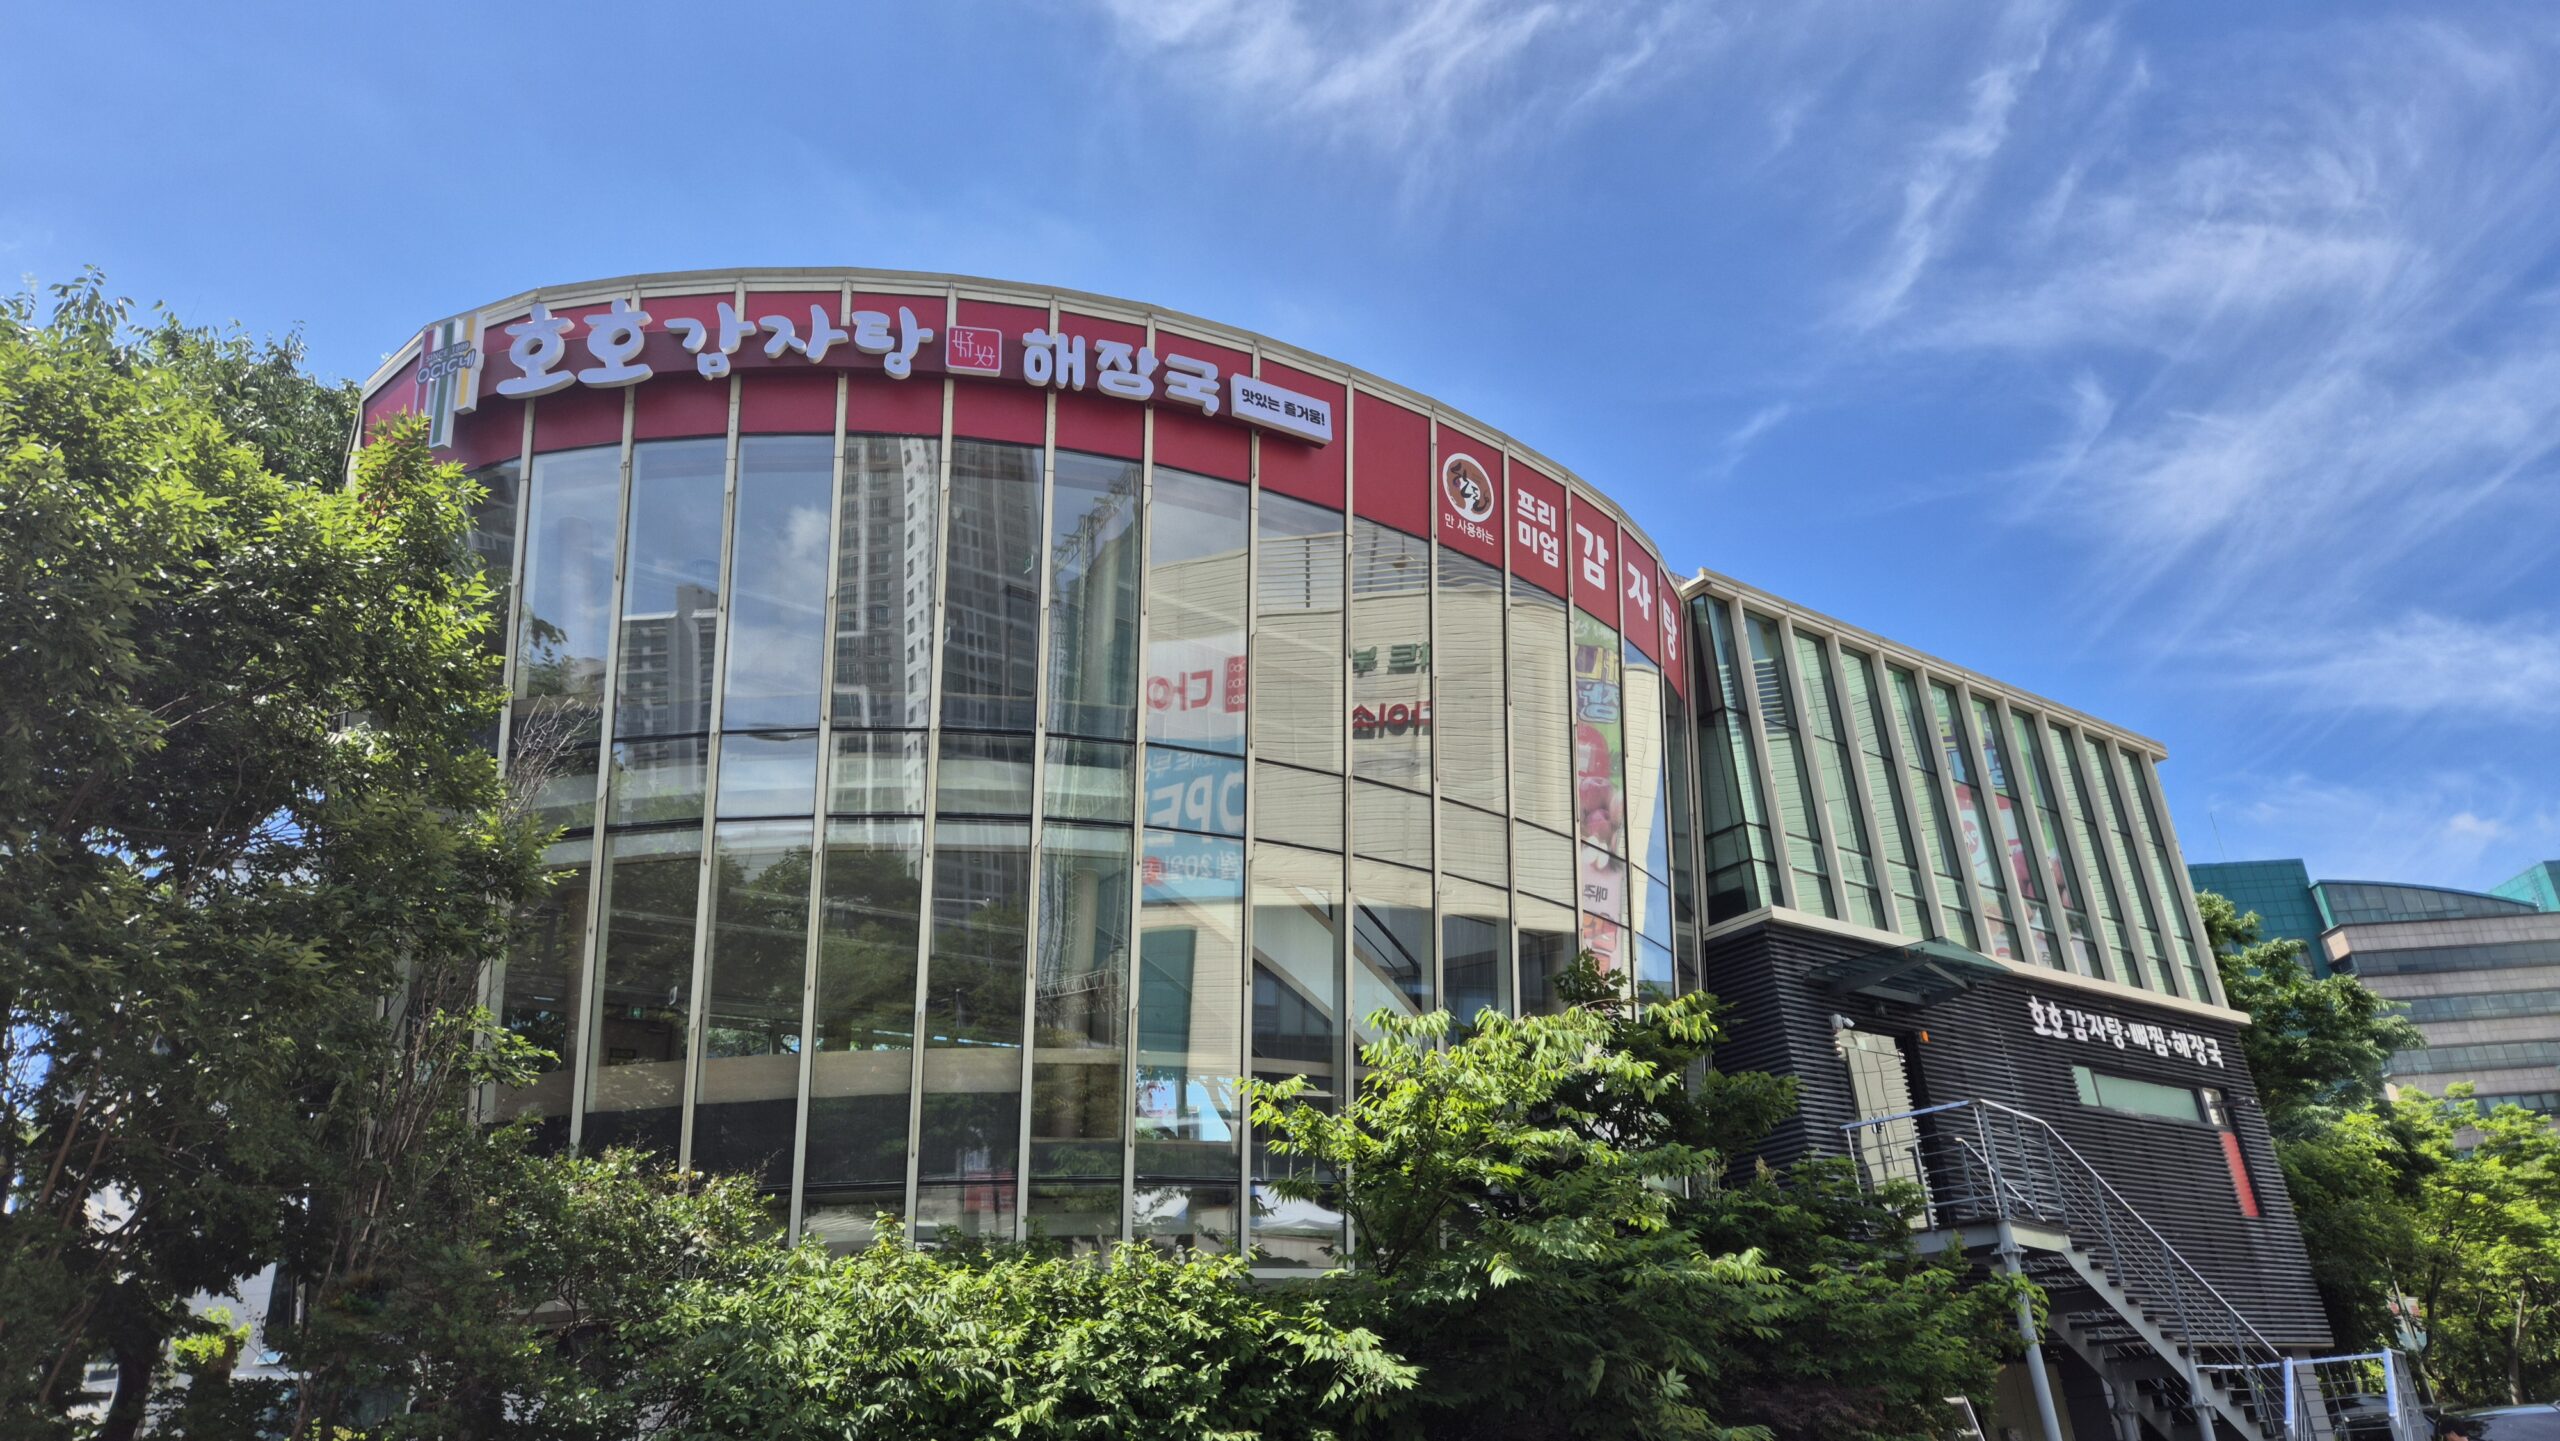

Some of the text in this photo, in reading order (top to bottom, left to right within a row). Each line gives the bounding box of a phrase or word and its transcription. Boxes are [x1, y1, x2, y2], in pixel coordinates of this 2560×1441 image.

[1022, 328, 1221, 417] 해장국
[1241, 387, 1326, 427] 맛있는 즐거움!
[1444, 512, 1495, 546] 만 사용하는
[1517, 488, 1556, 533] 프리
[1518, 520, 1559, 568] 미엄
